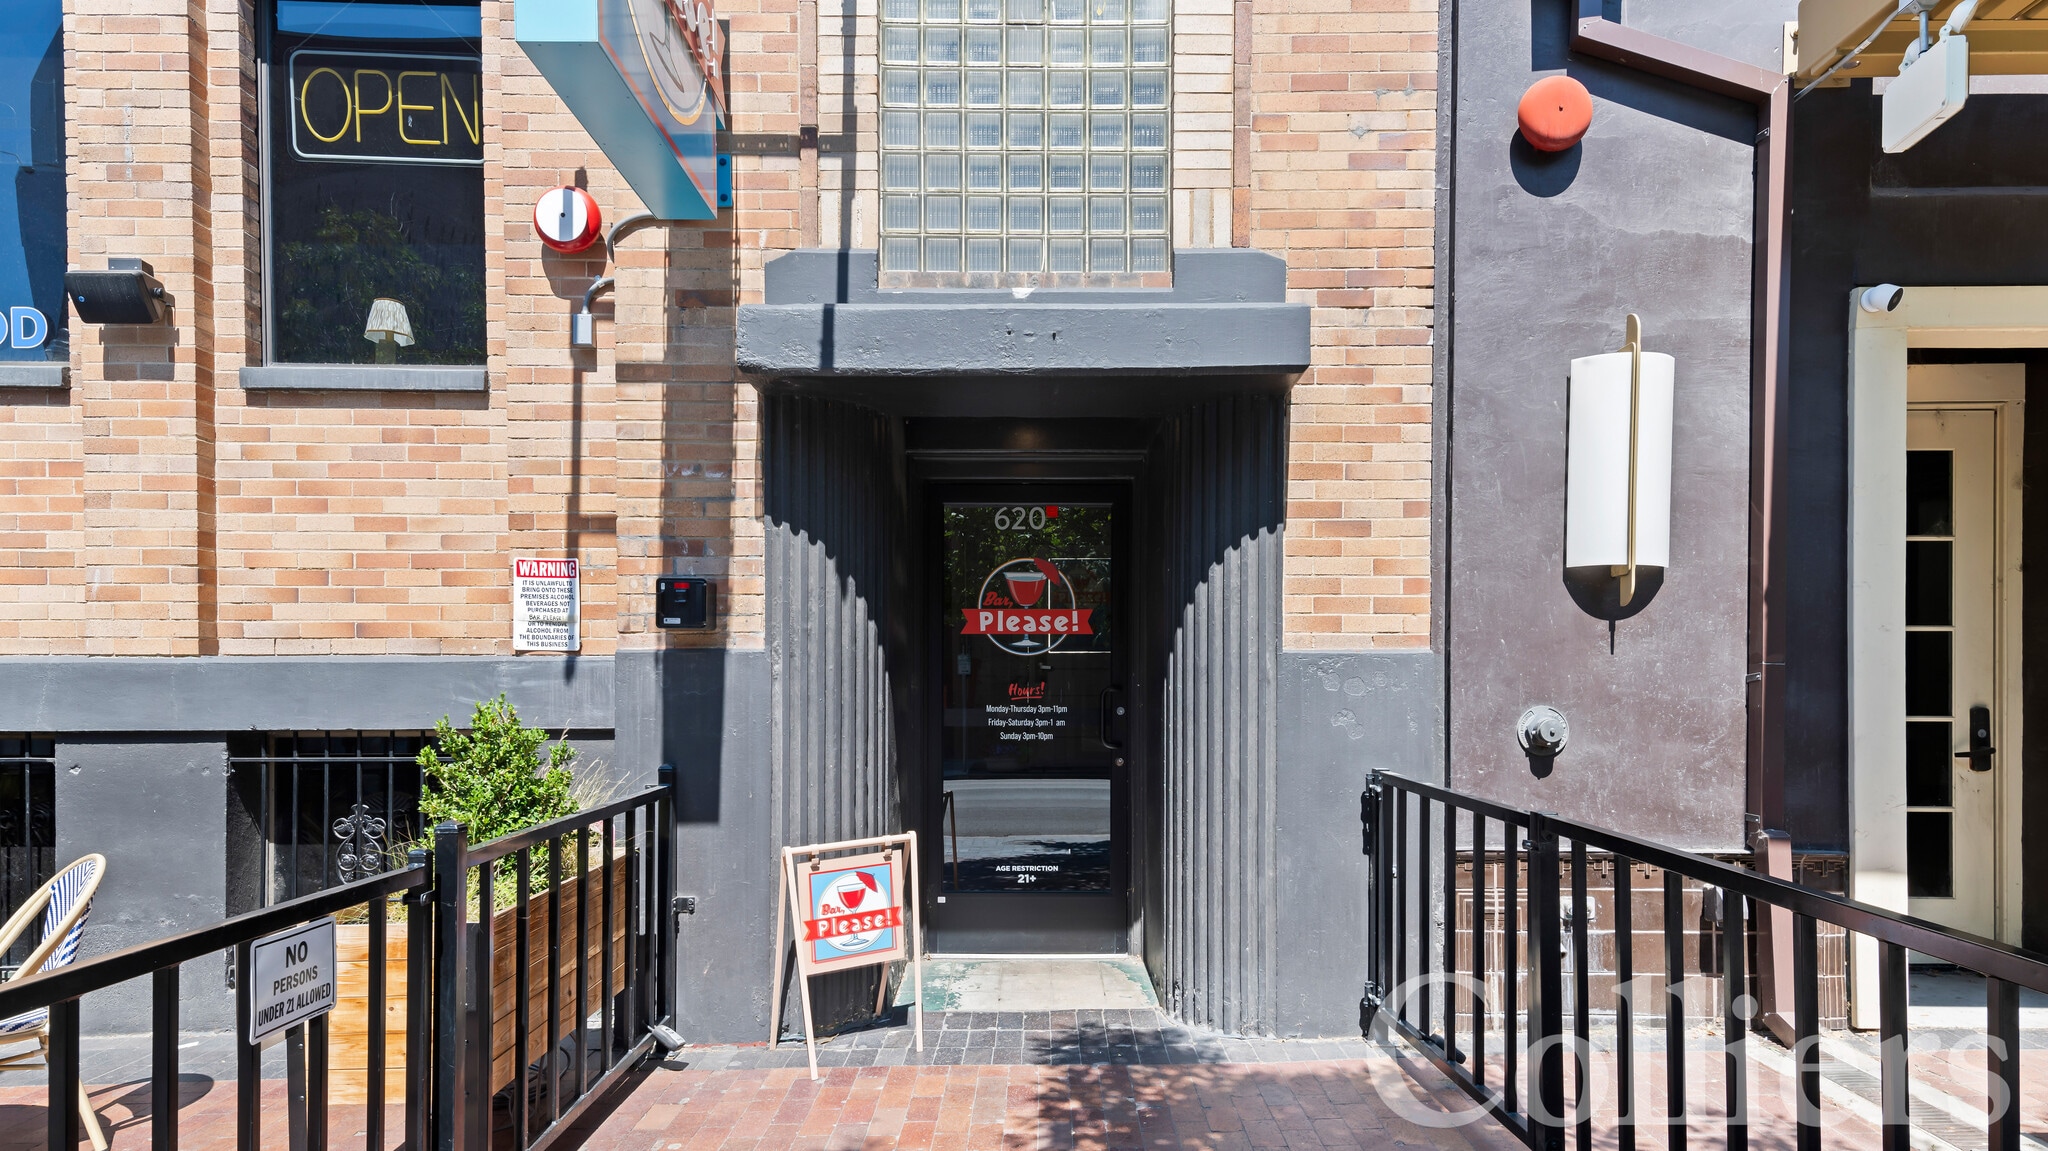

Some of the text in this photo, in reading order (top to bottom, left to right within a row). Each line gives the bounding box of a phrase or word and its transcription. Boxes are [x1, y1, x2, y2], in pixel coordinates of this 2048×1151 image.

[301, 67, 480, 145] OPEN
[993, 506, 1046, 531] 620
[519, 562, 576, 577] WARNING
[979, 609, 1080, 633] Please!
[1008, 681, 1045, 697] Hours!
[986, 704, 1068, 714] Monday-Thursday 3pm-11pm
[988, 718, 1034, 728] Friday-Saturday
[1000, 732, 1054, 741] Sunday 3pm-10pm
[1017, 874, 1037, 884] 21+
[817, 909, 893, 938] Please!
[285, 940, 308, 968] NO
[273, 965, 318, 996] PERSONS
[258, 1004, 284, 1027] UNDER
[285, 998, 295, 1015] 21
[296, 982, 331, 1010] ALLOWED
